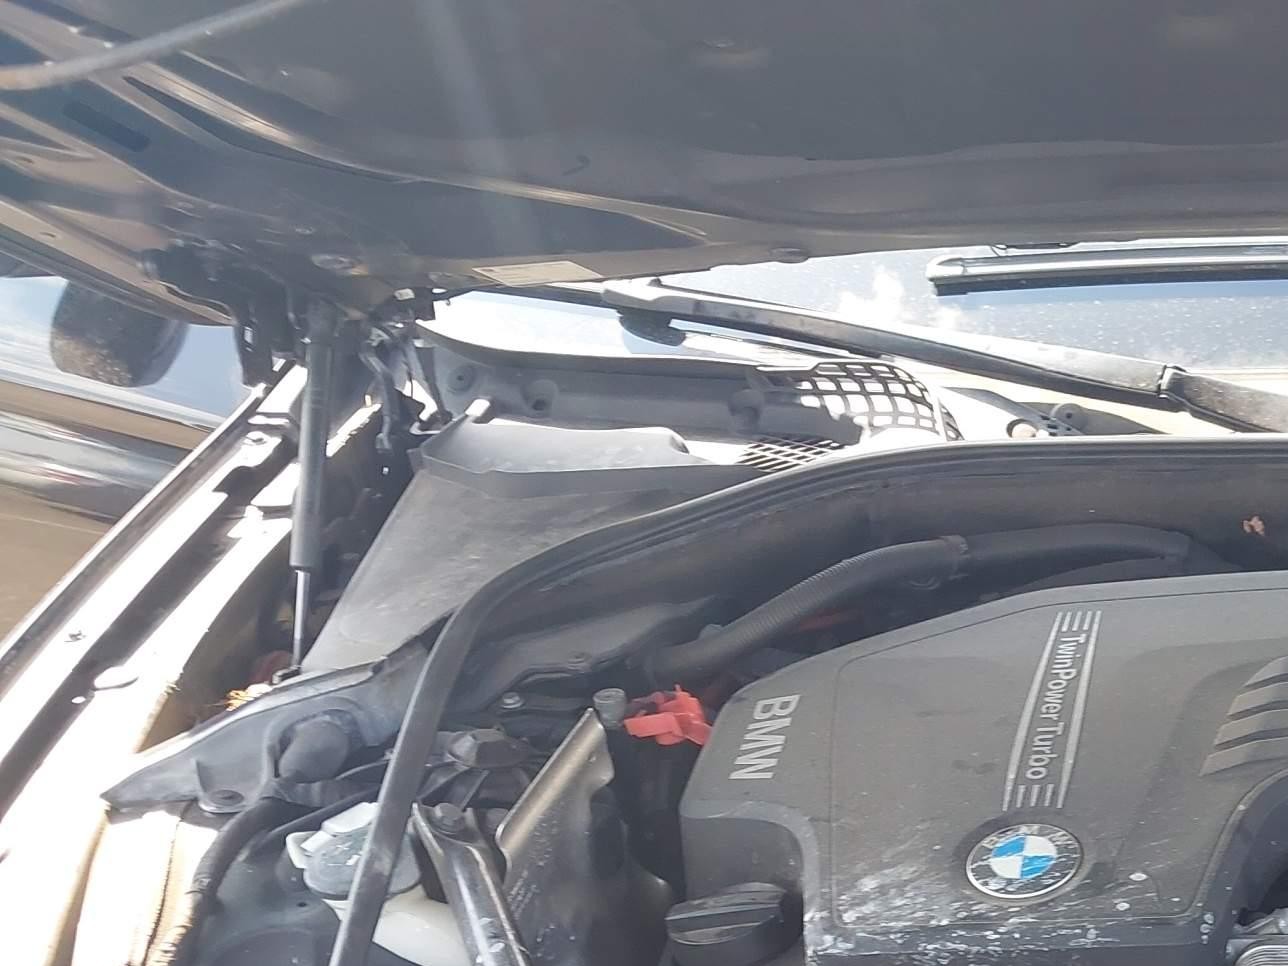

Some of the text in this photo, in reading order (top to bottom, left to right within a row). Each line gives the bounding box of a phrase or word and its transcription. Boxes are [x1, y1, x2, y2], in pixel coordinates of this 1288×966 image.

[729, 694, 801, 779] BMW
[1025, 633, 1086, 779] TwinPower Turbo
